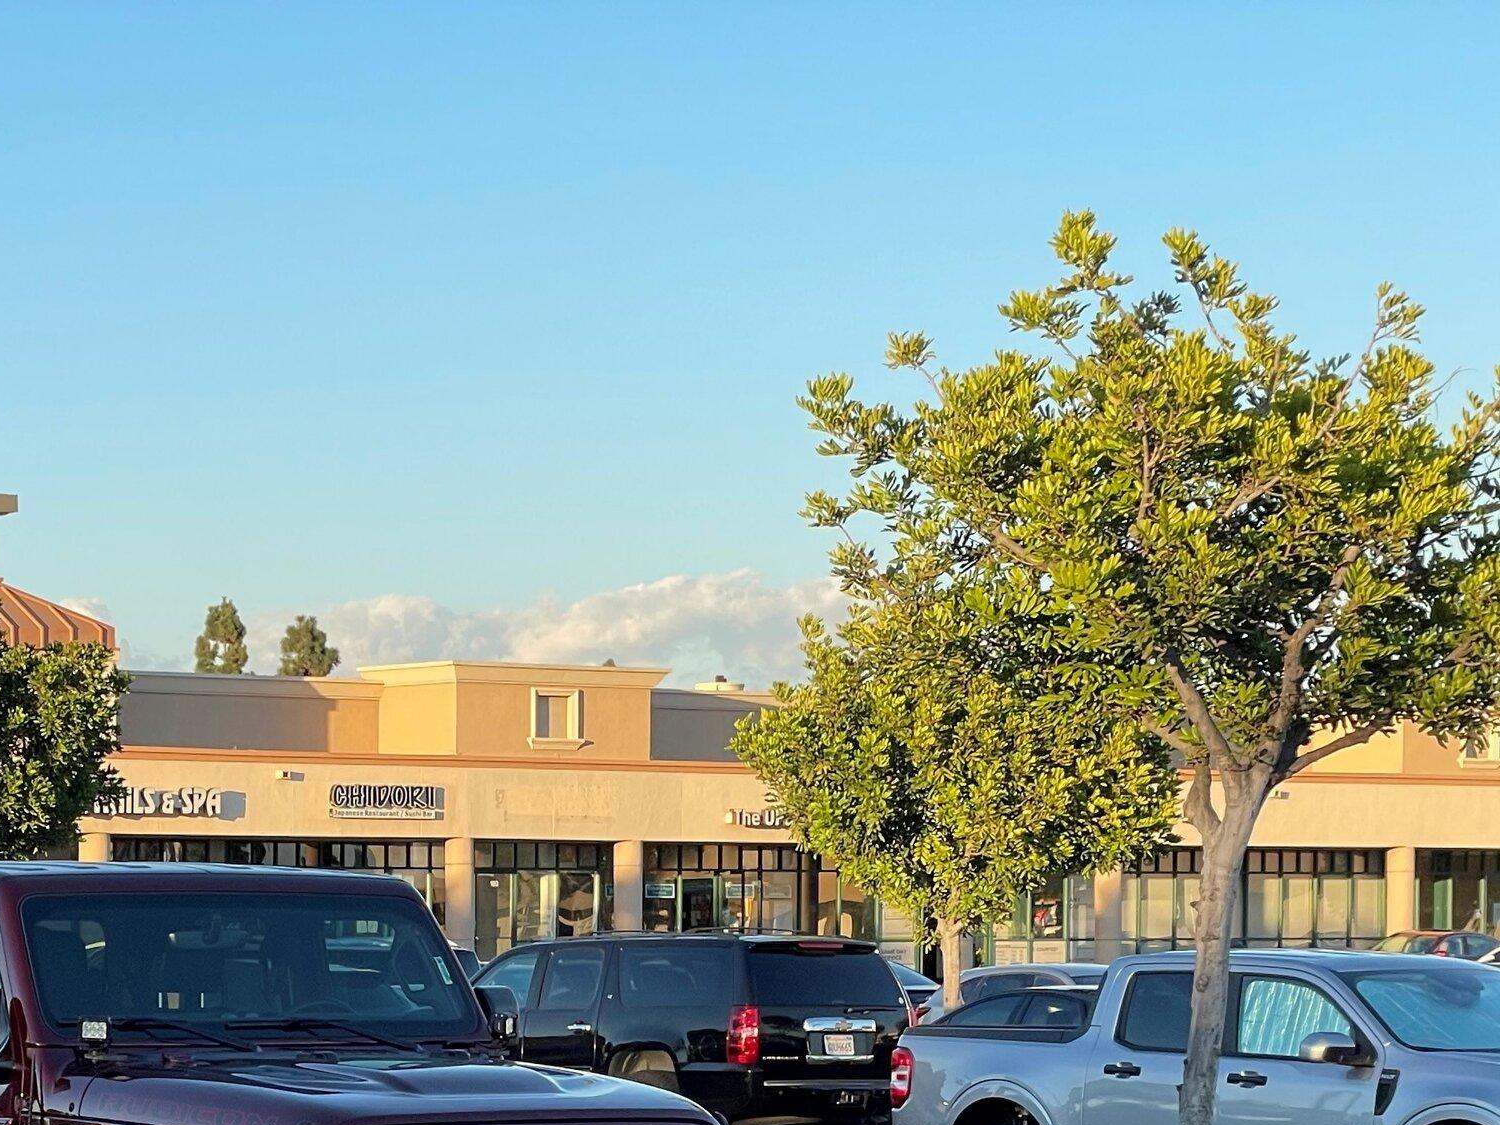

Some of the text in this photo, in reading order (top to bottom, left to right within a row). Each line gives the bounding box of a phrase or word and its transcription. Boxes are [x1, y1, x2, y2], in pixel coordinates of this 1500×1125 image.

[161, 791, 174, 814] &
[181, 787, 222, 816] SPA
[332, 784, 436, 809] CHIDORI
[334, 809, 364, 817] Japanese
[734, 808, 760, 826] The
